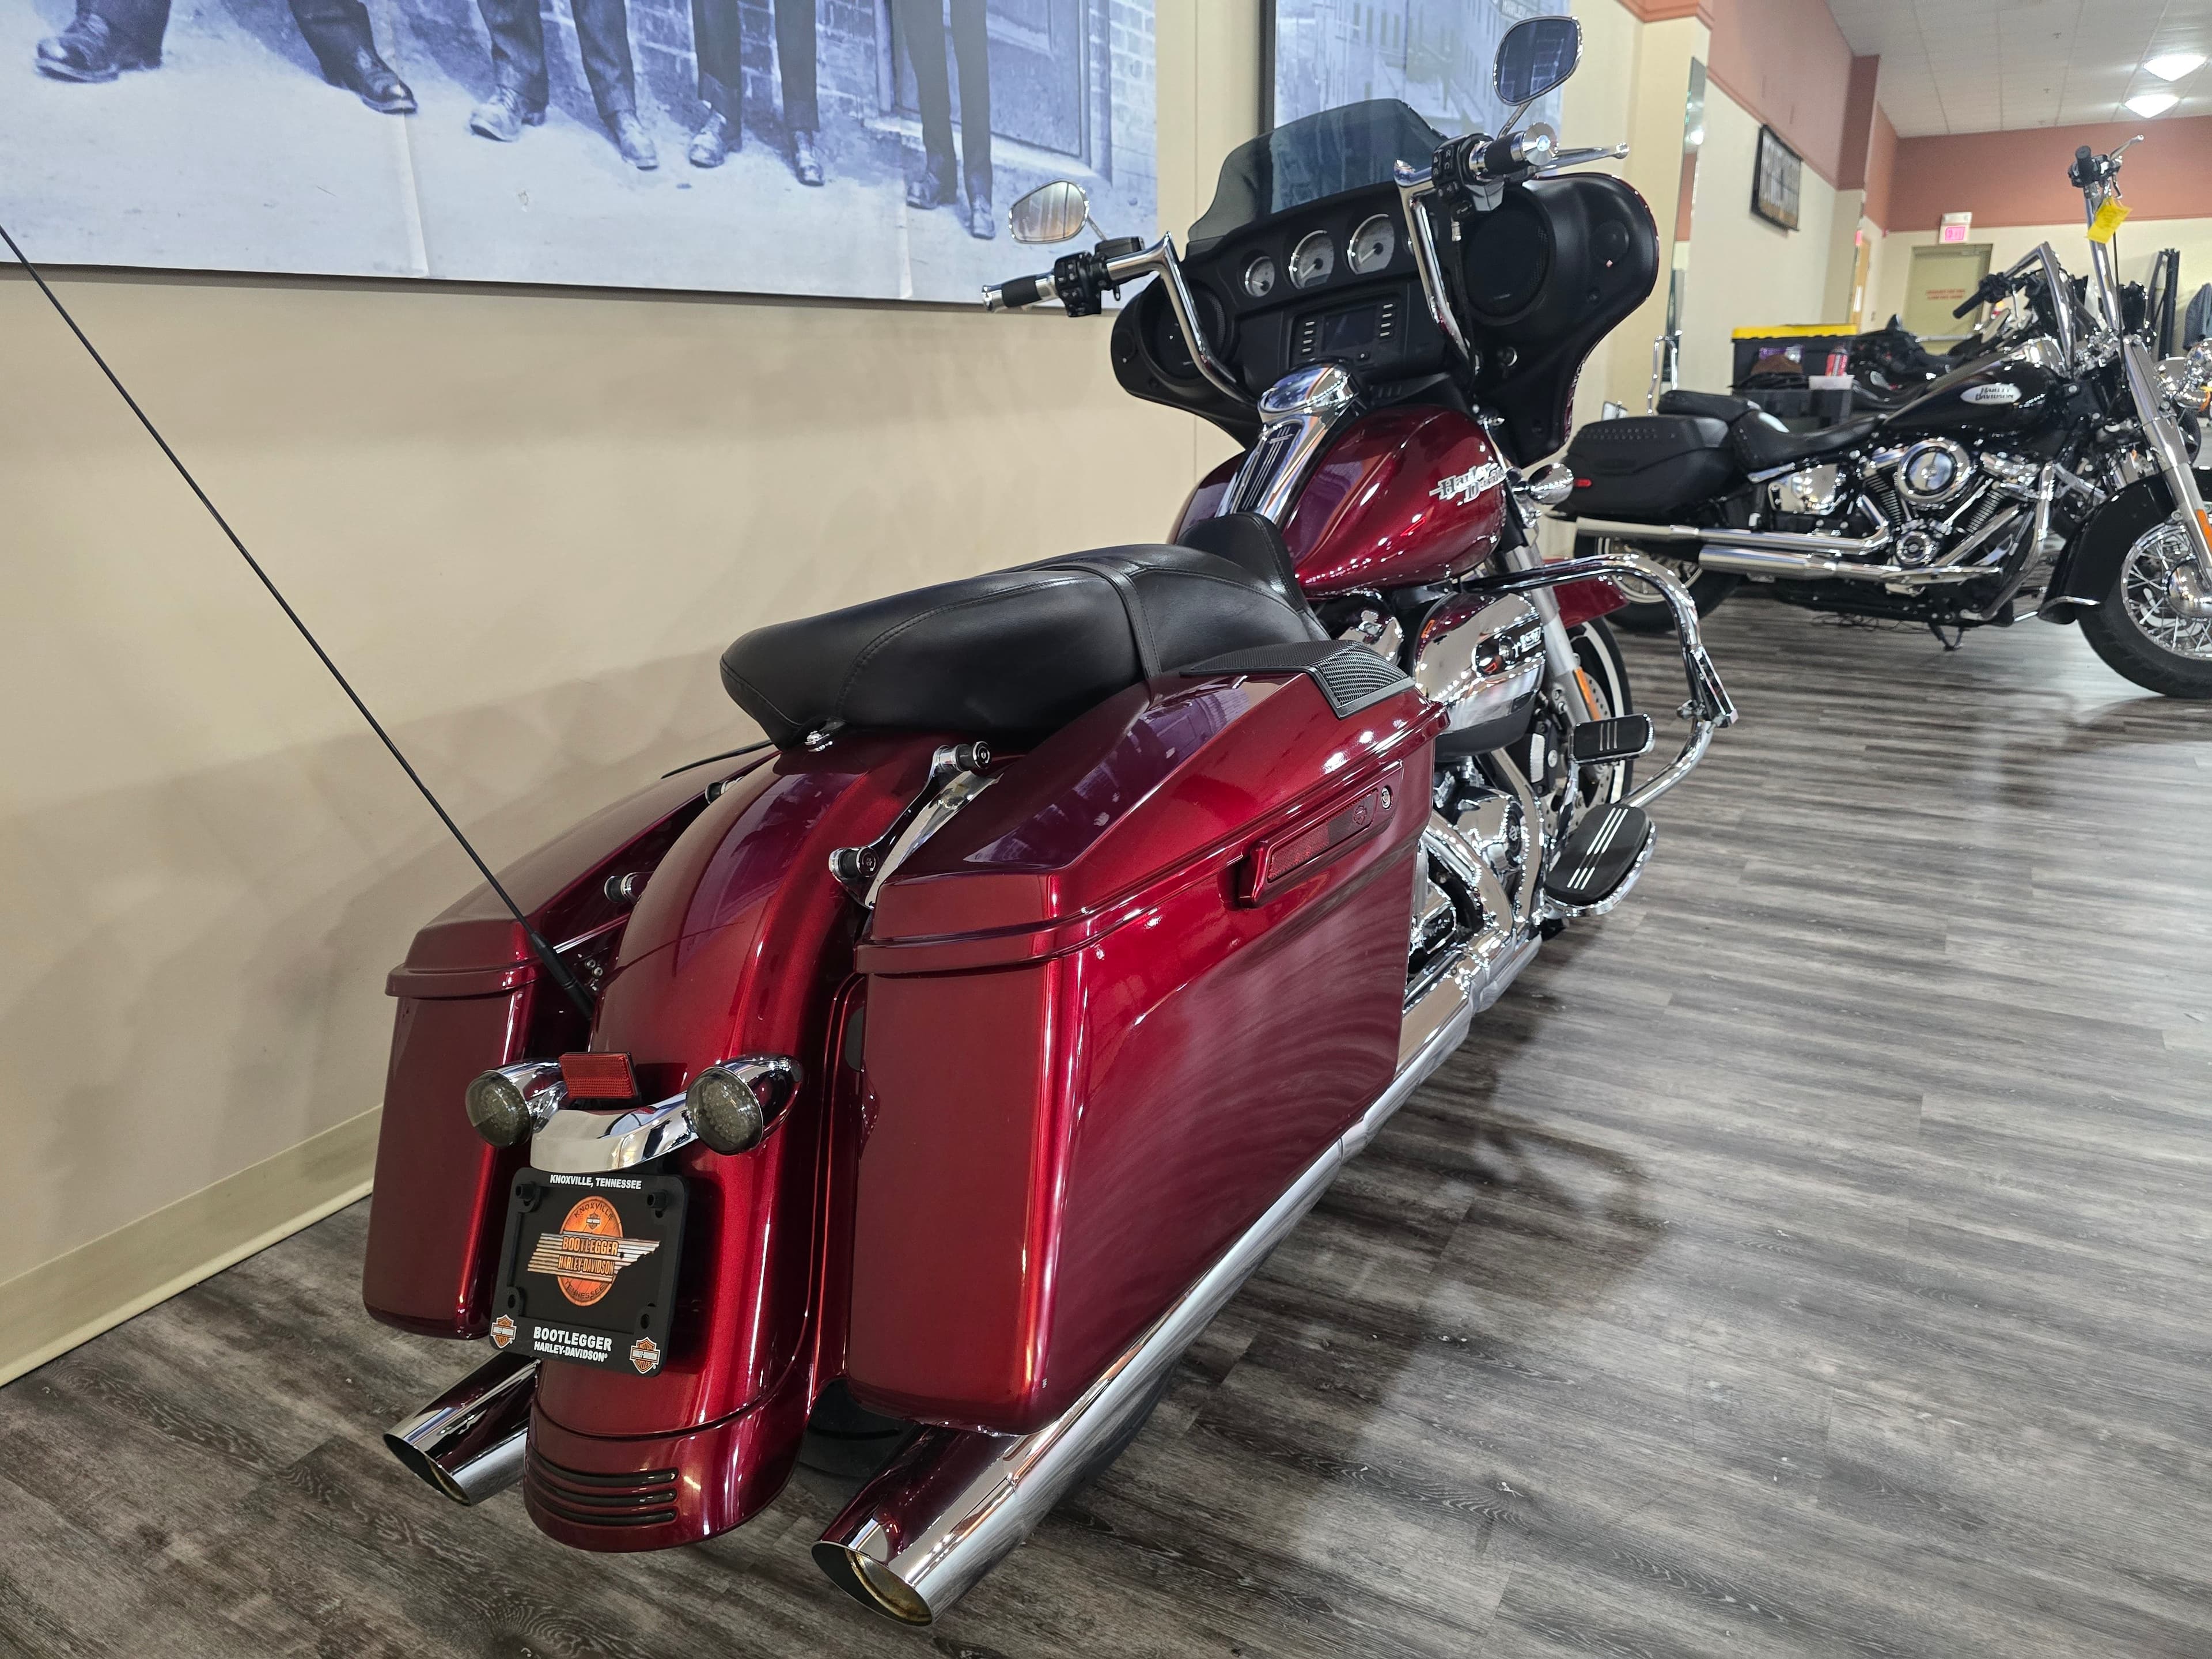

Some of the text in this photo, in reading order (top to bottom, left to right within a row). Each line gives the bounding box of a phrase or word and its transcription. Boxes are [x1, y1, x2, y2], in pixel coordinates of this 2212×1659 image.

[550, 1174, 642, 1190] KNOXVILLE, TENNESSEE
[574, 1202, 615, 1221] KNOXVILLE
[562, 1236, 619, 1256] BOOTLEGGER
[558, 1255, 615, 1275] HARLEY-DAVIDSON
[564, 1278, 605, 1300] TENNESSEE
[533, 1326, 612, 1351] BOOTLEGGER
